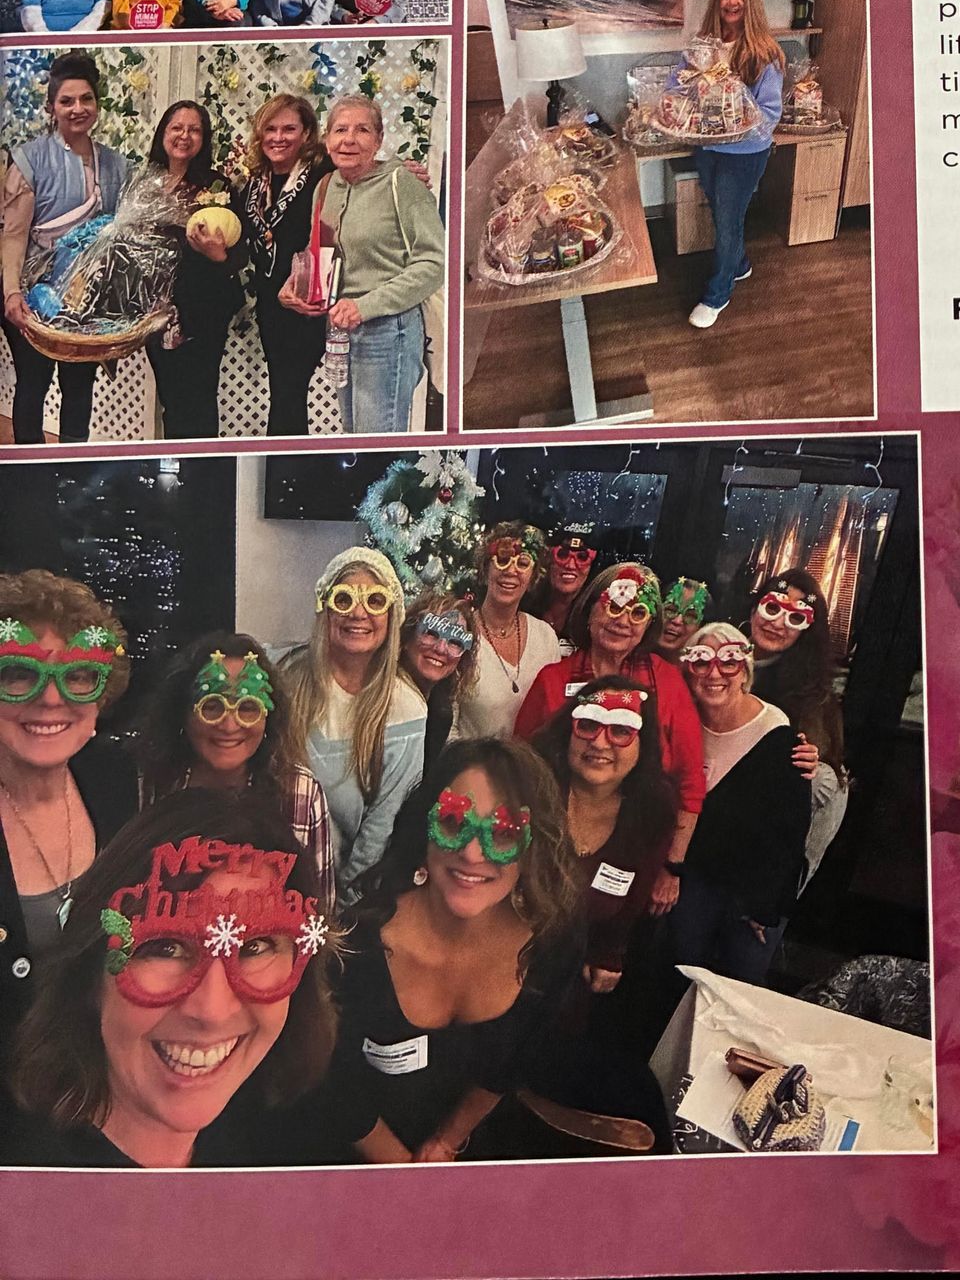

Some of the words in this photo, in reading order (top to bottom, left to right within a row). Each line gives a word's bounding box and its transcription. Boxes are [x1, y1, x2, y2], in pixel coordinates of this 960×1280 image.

[136, 3, 159, 13] STOP
[152, 836, 298, 888] Merry
[108, 884, 318, 923] Christmas
